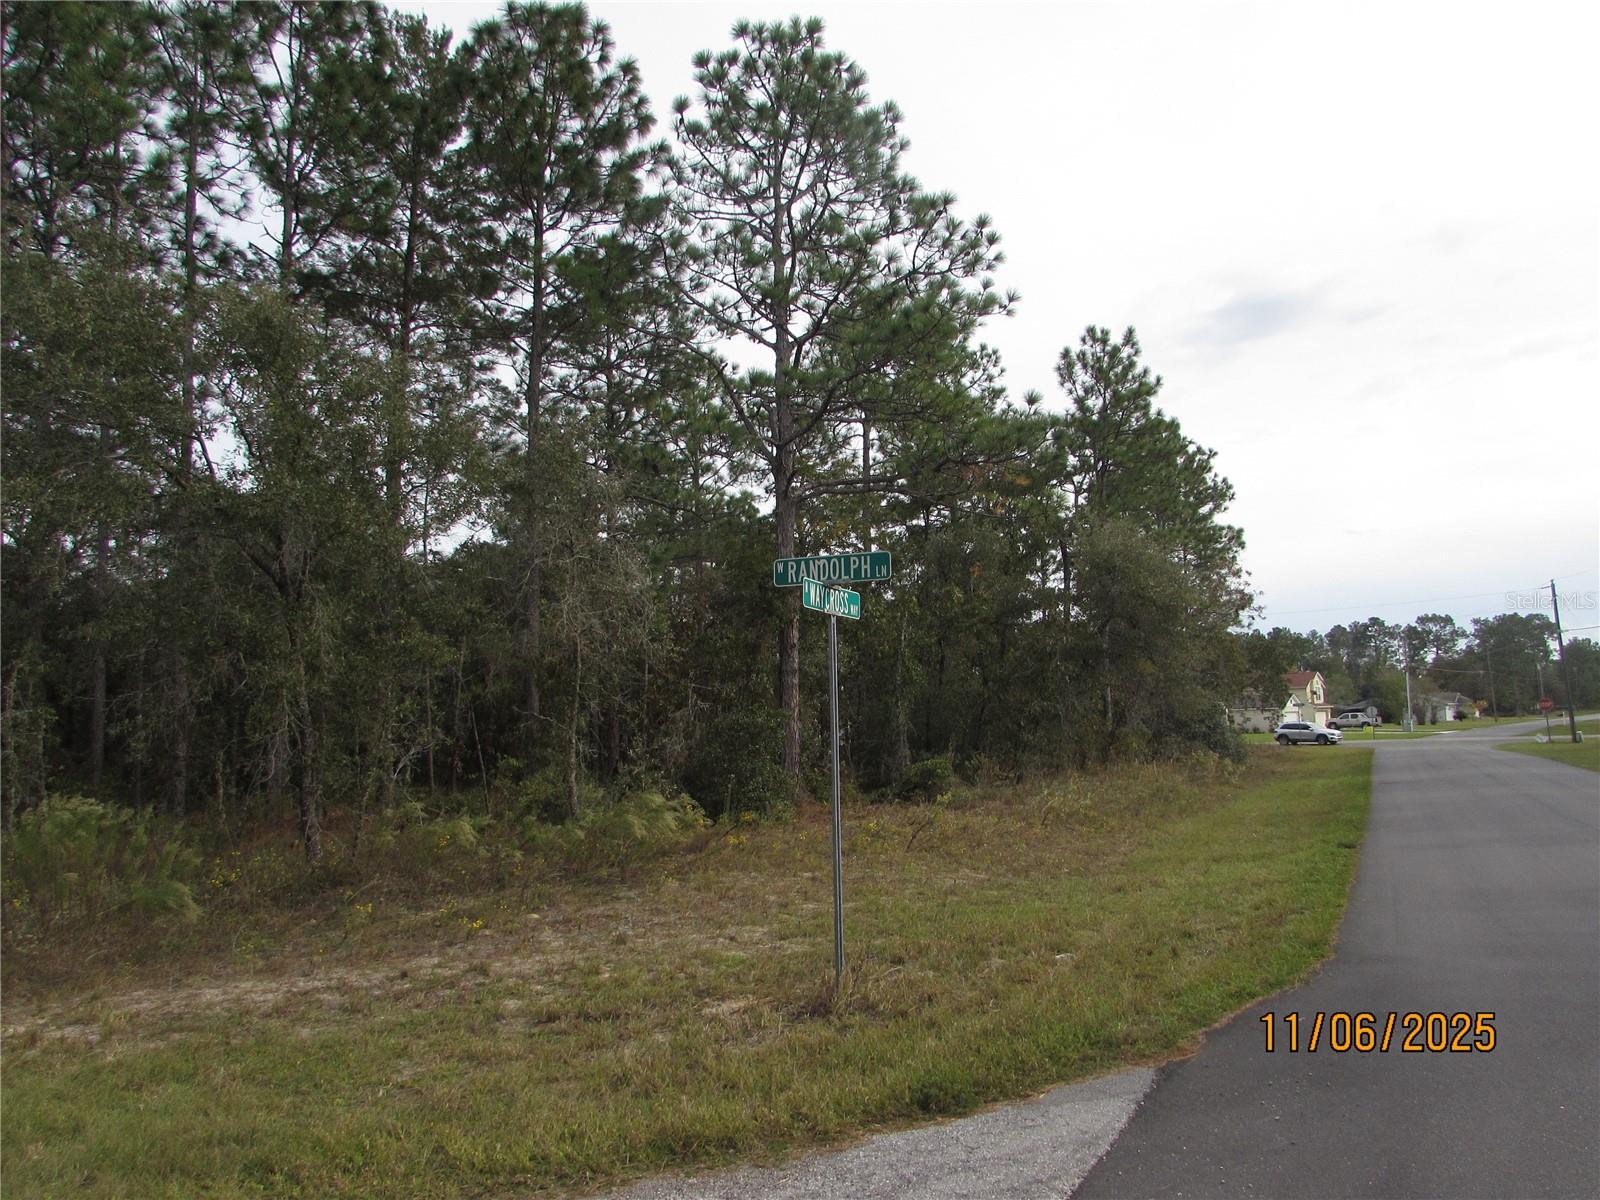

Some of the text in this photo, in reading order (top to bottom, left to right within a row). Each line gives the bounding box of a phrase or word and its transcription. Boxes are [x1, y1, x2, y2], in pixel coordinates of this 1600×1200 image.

[777, 555, 887, 583] W RANDOLPH LN
[810, 582, 849, 614] WAYCROSS
